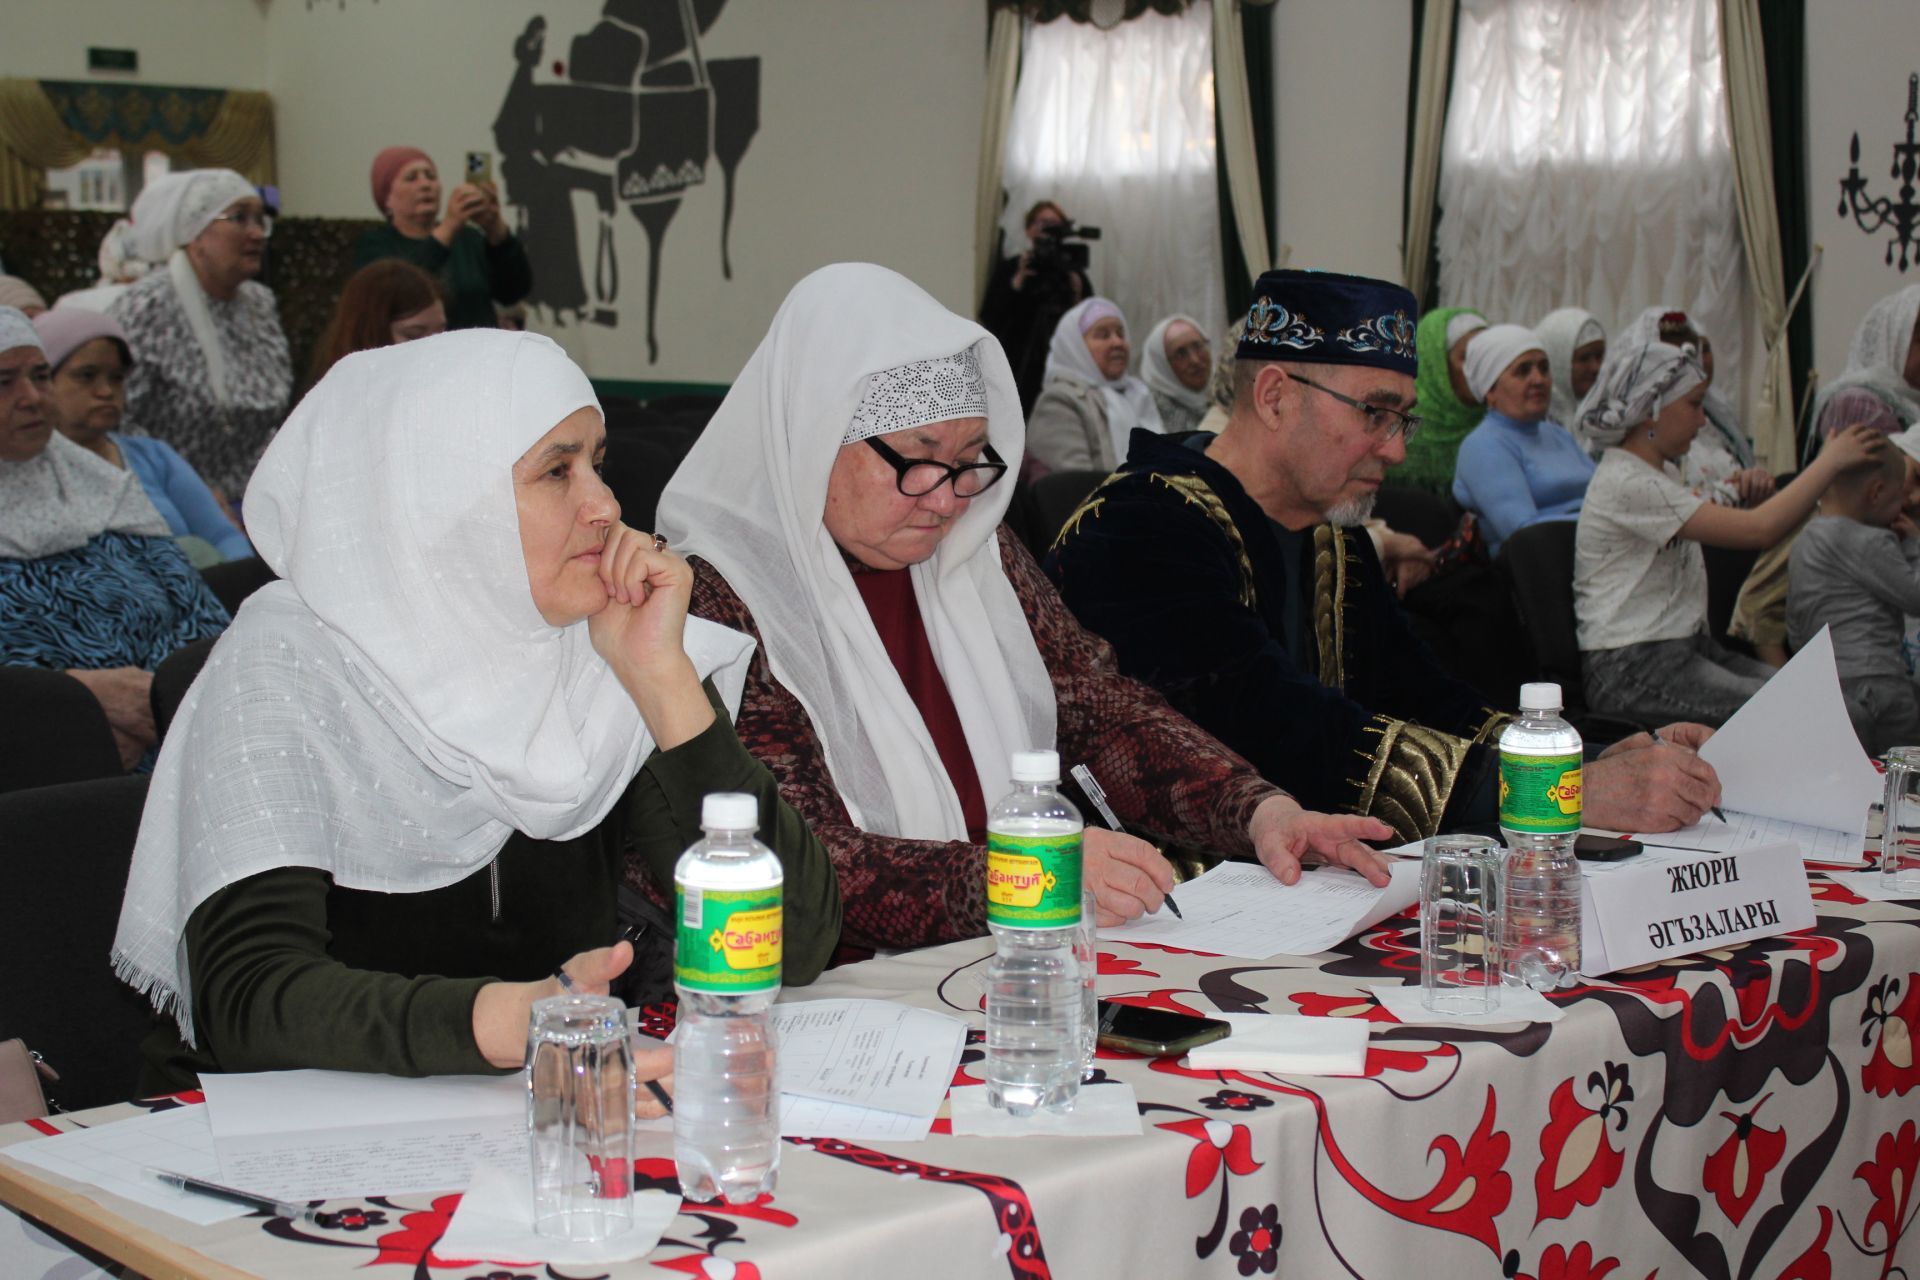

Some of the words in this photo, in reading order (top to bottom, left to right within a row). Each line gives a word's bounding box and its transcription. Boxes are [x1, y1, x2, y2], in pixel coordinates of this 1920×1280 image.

[988, 868, 1041, 890] абантуй
[1667, 856, 1739, 893] ЖЮРИ
[1648, 899, 1780, 949] ӘГЪЗАЛАРЫ
